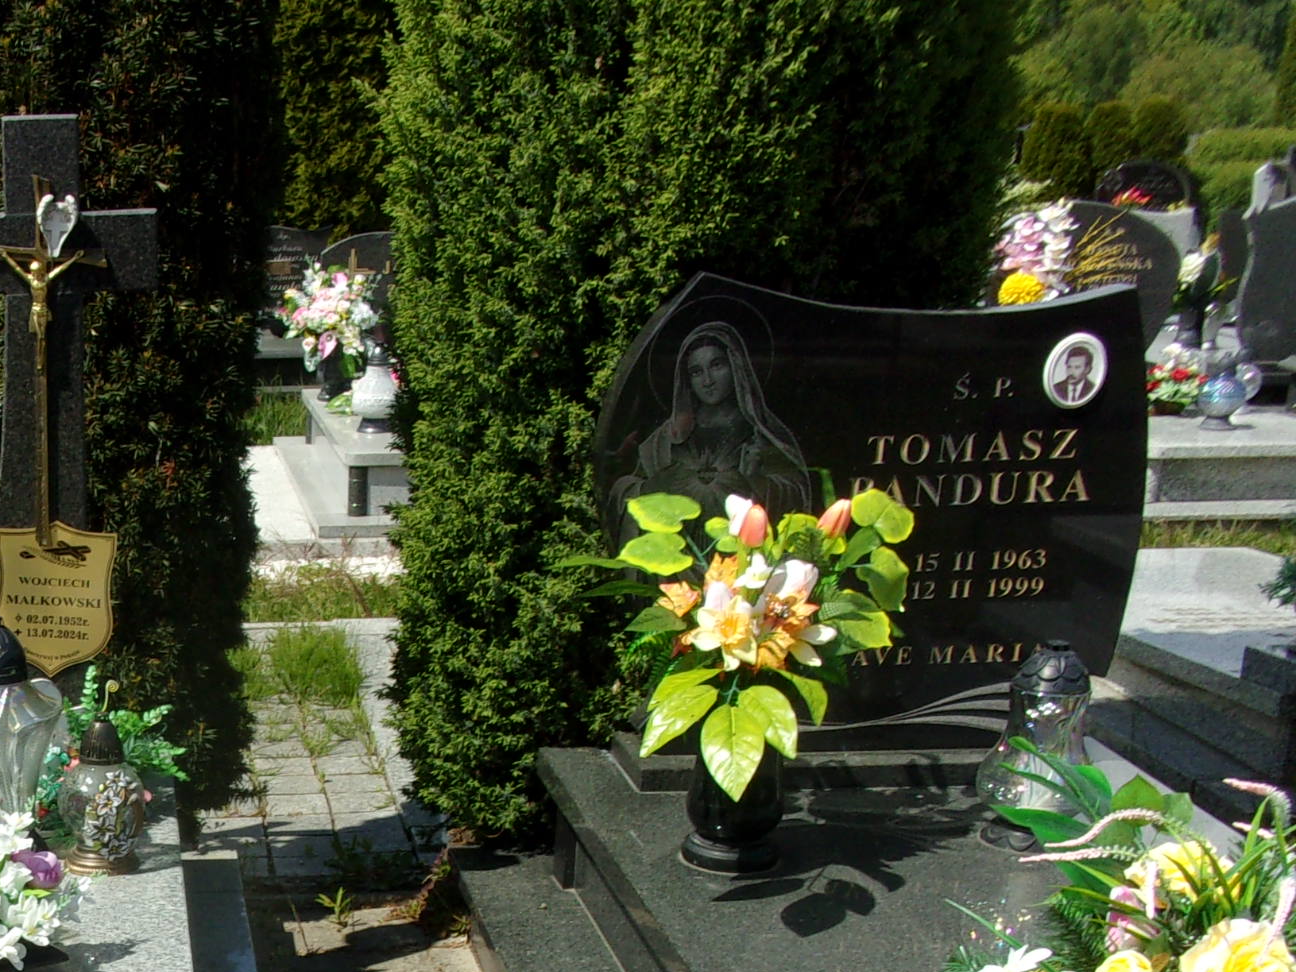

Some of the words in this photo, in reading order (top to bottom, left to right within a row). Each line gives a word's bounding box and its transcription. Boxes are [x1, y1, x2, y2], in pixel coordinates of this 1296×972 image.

[955, 372, 978, 400] Ś.
[993, 377, 1014, 398] P.
[867, 429, 1079, 465] TOMASZ
[915, 552, 940, 573] 15
[953, 551, 976, 571] II
[991, 549, 1047, 571] 1963
[18, 576, 90, 588] WOJCIECH
[911, 580, 936, 600] 12
[950, 579, 973, 598] II
[986, 577, 1045, 598] 1999
[26, 628, 89, 640] 13.07.2024r.
[851, 646, 912, 667] AVE
[929, 642, 1042, 665] MARI
